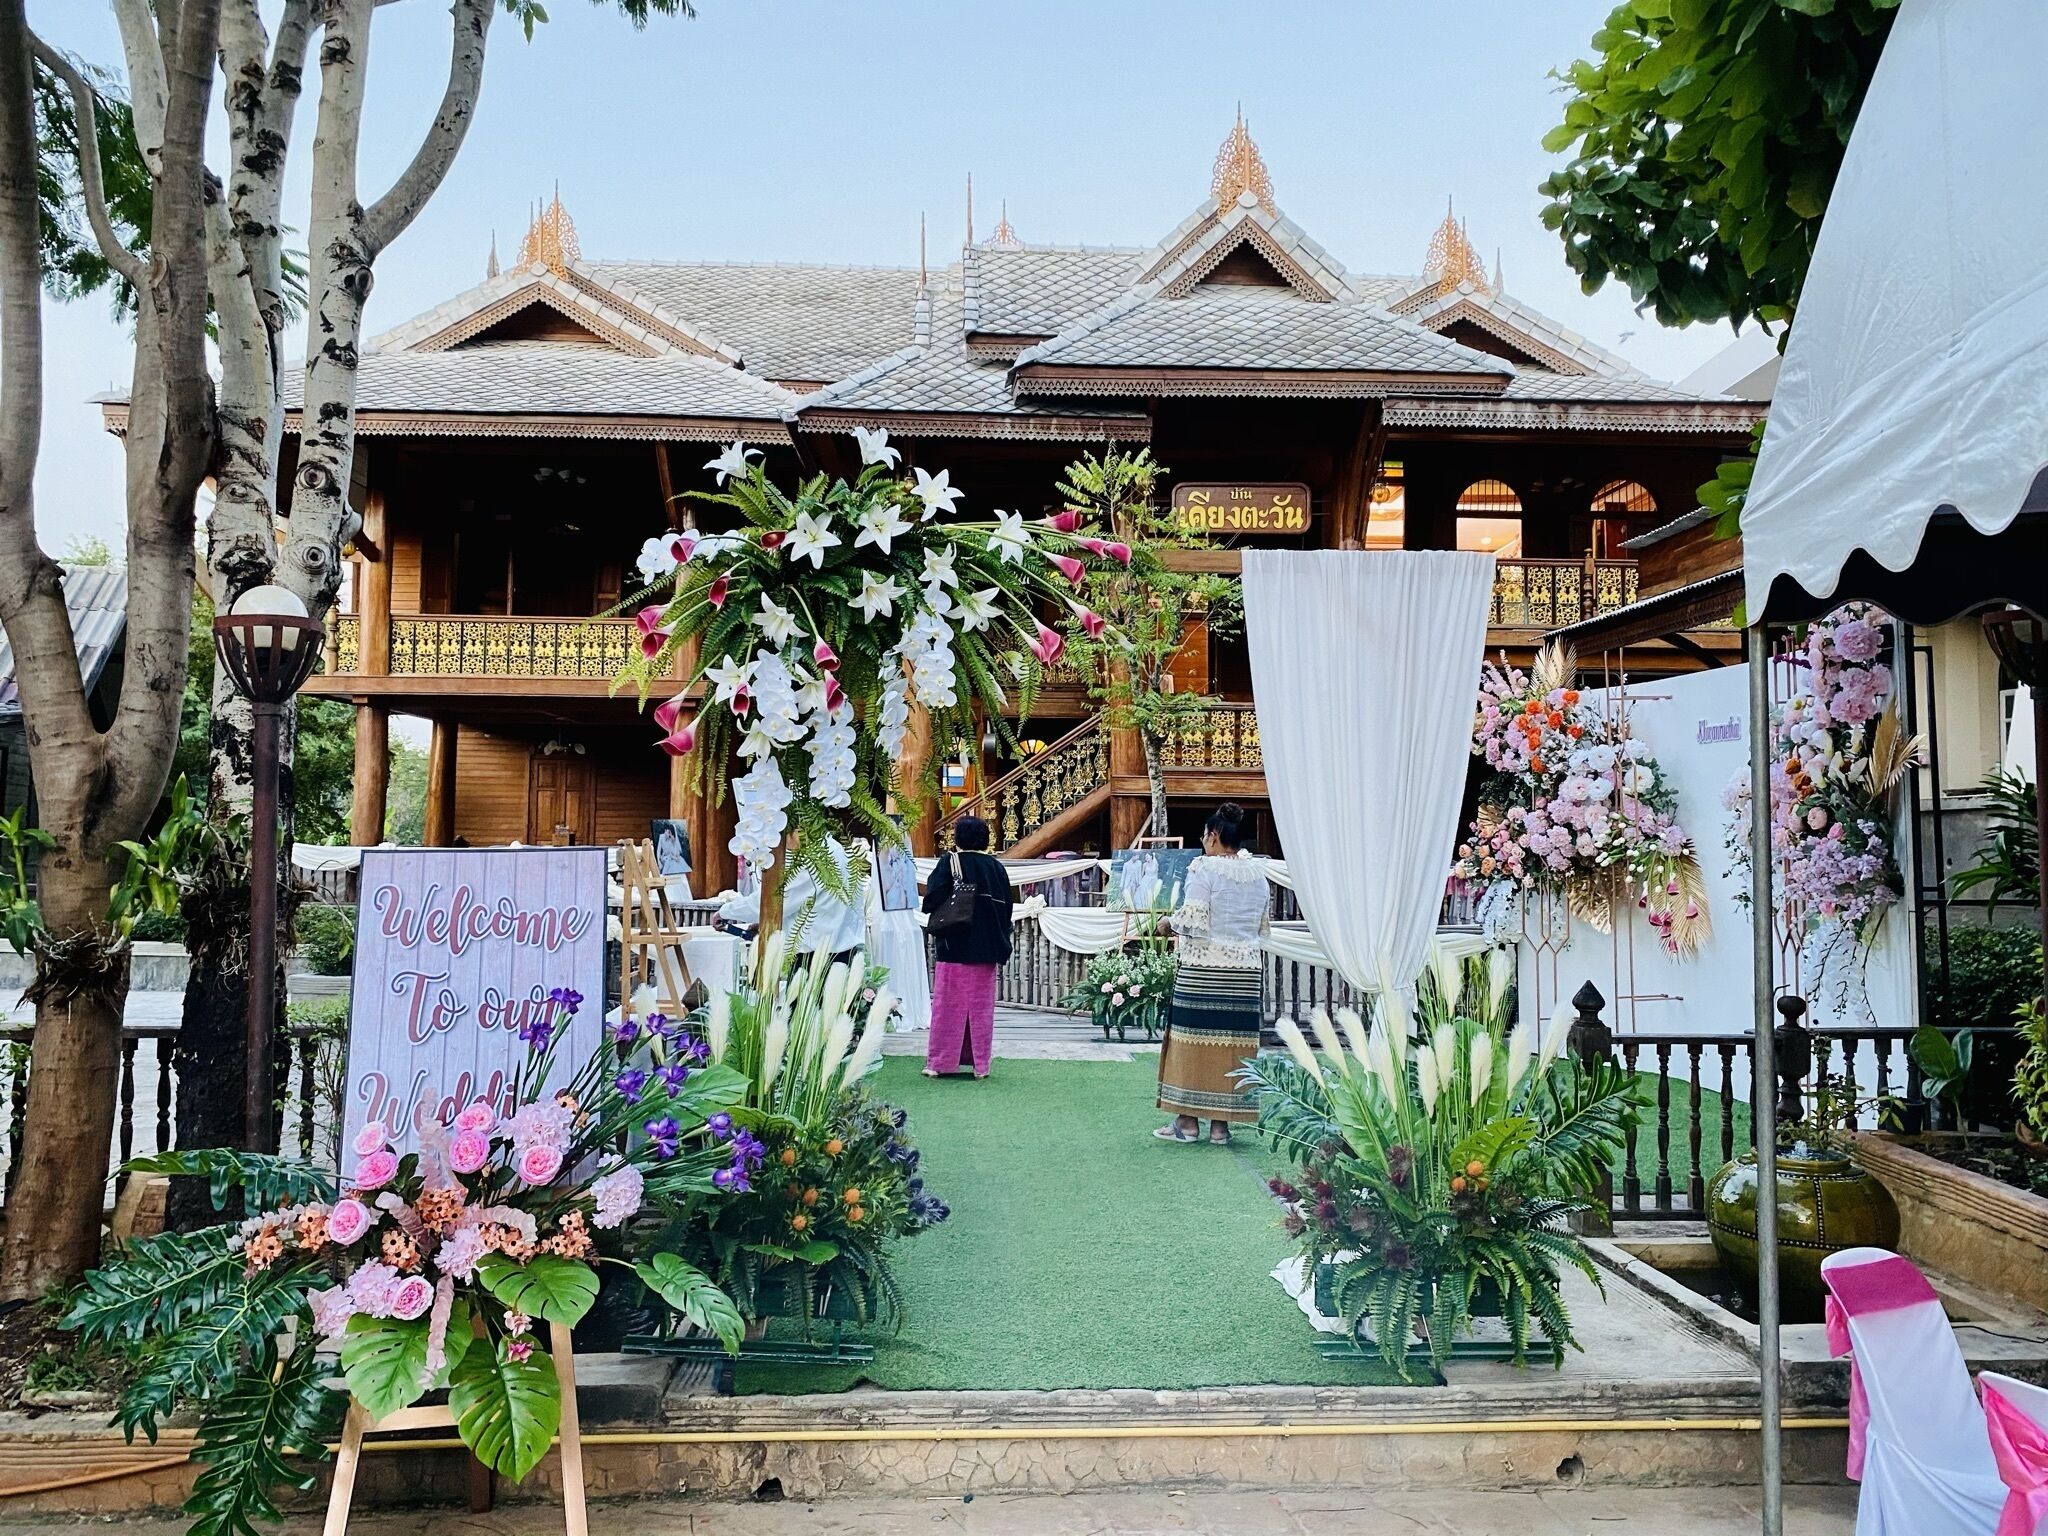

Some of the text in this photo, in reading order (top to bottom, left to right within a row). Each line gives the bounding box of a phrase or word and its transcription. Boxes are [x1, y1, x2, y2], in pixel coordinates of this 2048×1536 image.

[1230, 487, 1252, 500] บ้าน
[374, 883, 592, 956] Welcome
[391, 969, 560, 1046] To our
